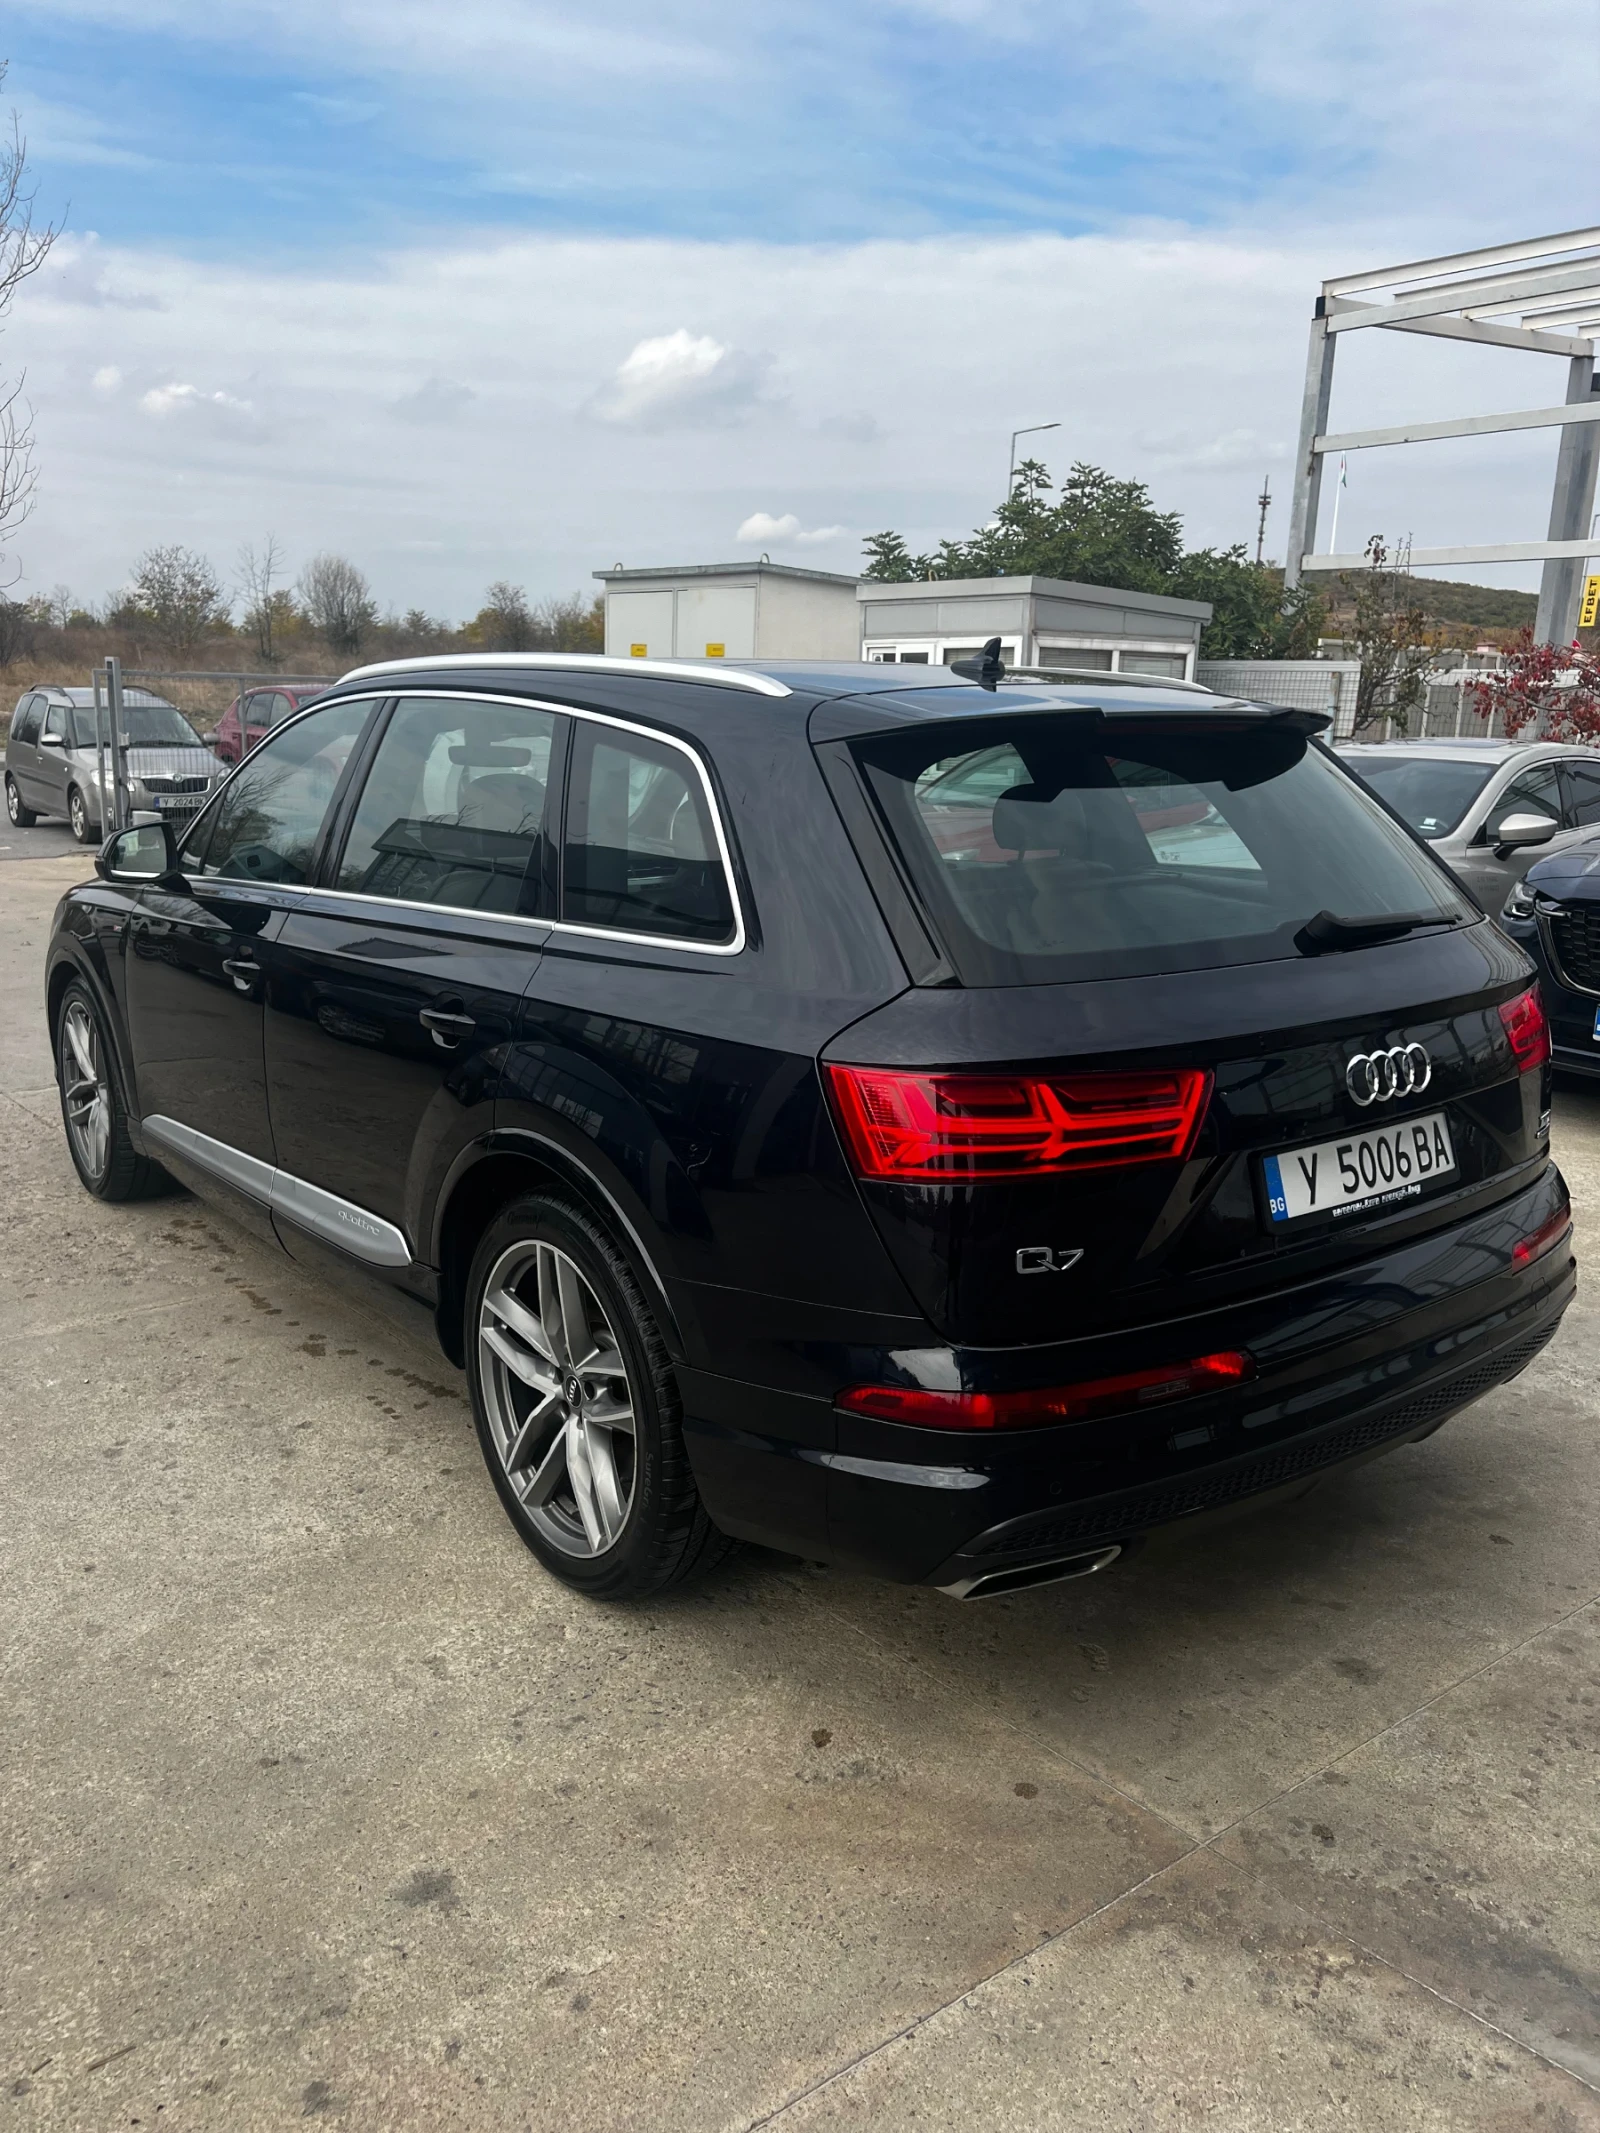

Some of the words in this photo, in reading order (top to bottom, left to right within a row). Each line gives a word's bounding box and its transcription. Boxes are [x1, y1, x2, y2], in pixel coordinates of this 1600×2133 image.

[1583, 578, 1598, 624] EFBET
[1269, 1196, 1286, 1214] BG
[338, 1210, 380, 1236] quattro
[1016, 1246, 1085, 1275] Q7
